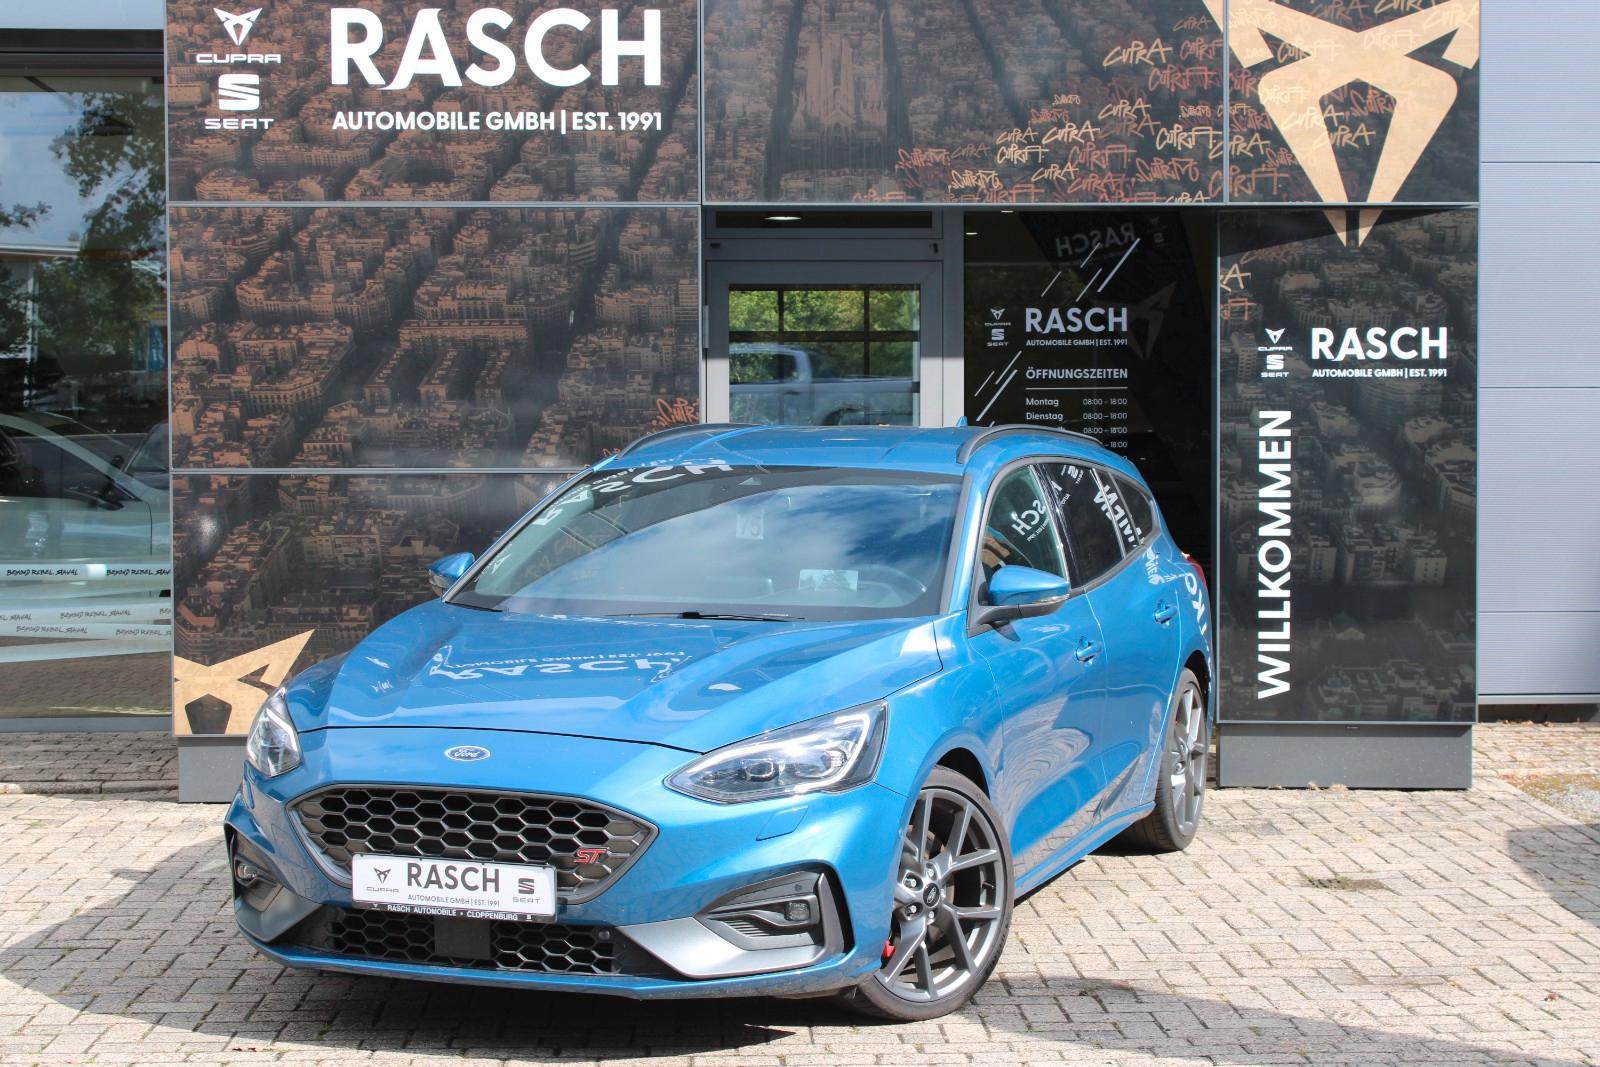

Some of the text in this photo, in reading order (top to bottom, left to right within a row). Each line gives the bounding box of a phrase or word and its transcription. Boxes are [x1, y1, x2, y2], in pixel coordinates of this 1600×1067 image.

[330, 8, 661, 90] RASCH
[1102, 38, 1173, 68] CUPRA
[196, 53, 281, 64] CUPRA
[1098, 98, 1151, 120] CUPRA
[204, 118, 274, 129] SEAT
[333, 111, 480, 131] AUTOMOBILE
[487, 111, 555, 131] GMBH
[572, 111, 613, 131] EST.
[618, 111, 662, 131] 1991
[996, 127, 1039, 144] CUPRA
[1042, 120, 1100, 145] CUPRA
[1156, 124, 1222, 150] CUPRA
[1031, 162, 1079, 182] CUPRA
[1025, 307, 1127, 334] RASCH
[1026, 339, 1072, 347] AUTOMOBILE
[1312, 327, 1447, 361] RASCH
[1026, 366, 1128, 379] ÖFFNUNGSZEITEN
[1312, 369, 1372, 377] AUTOMOBILE
[1374, 368, 1403, 377] GMBH
[1409, 369, 1427, 377] EST.
[1428, 368, 1447, 377] 1991
[1025, 398, 1059, 407] Montag
[1026, 412, 1064, 421] Dienstag
[1258, 410, 1291, 699] WILLKOMMEN
[575, 849, 608, 863] ST
[407, 862, 500, 893] RASCH
[408, 894, 449, 904] AUTOMOBILE
[387, 904, 518, 921] RASCH AUTOMOBILE CLOPPENBURG
